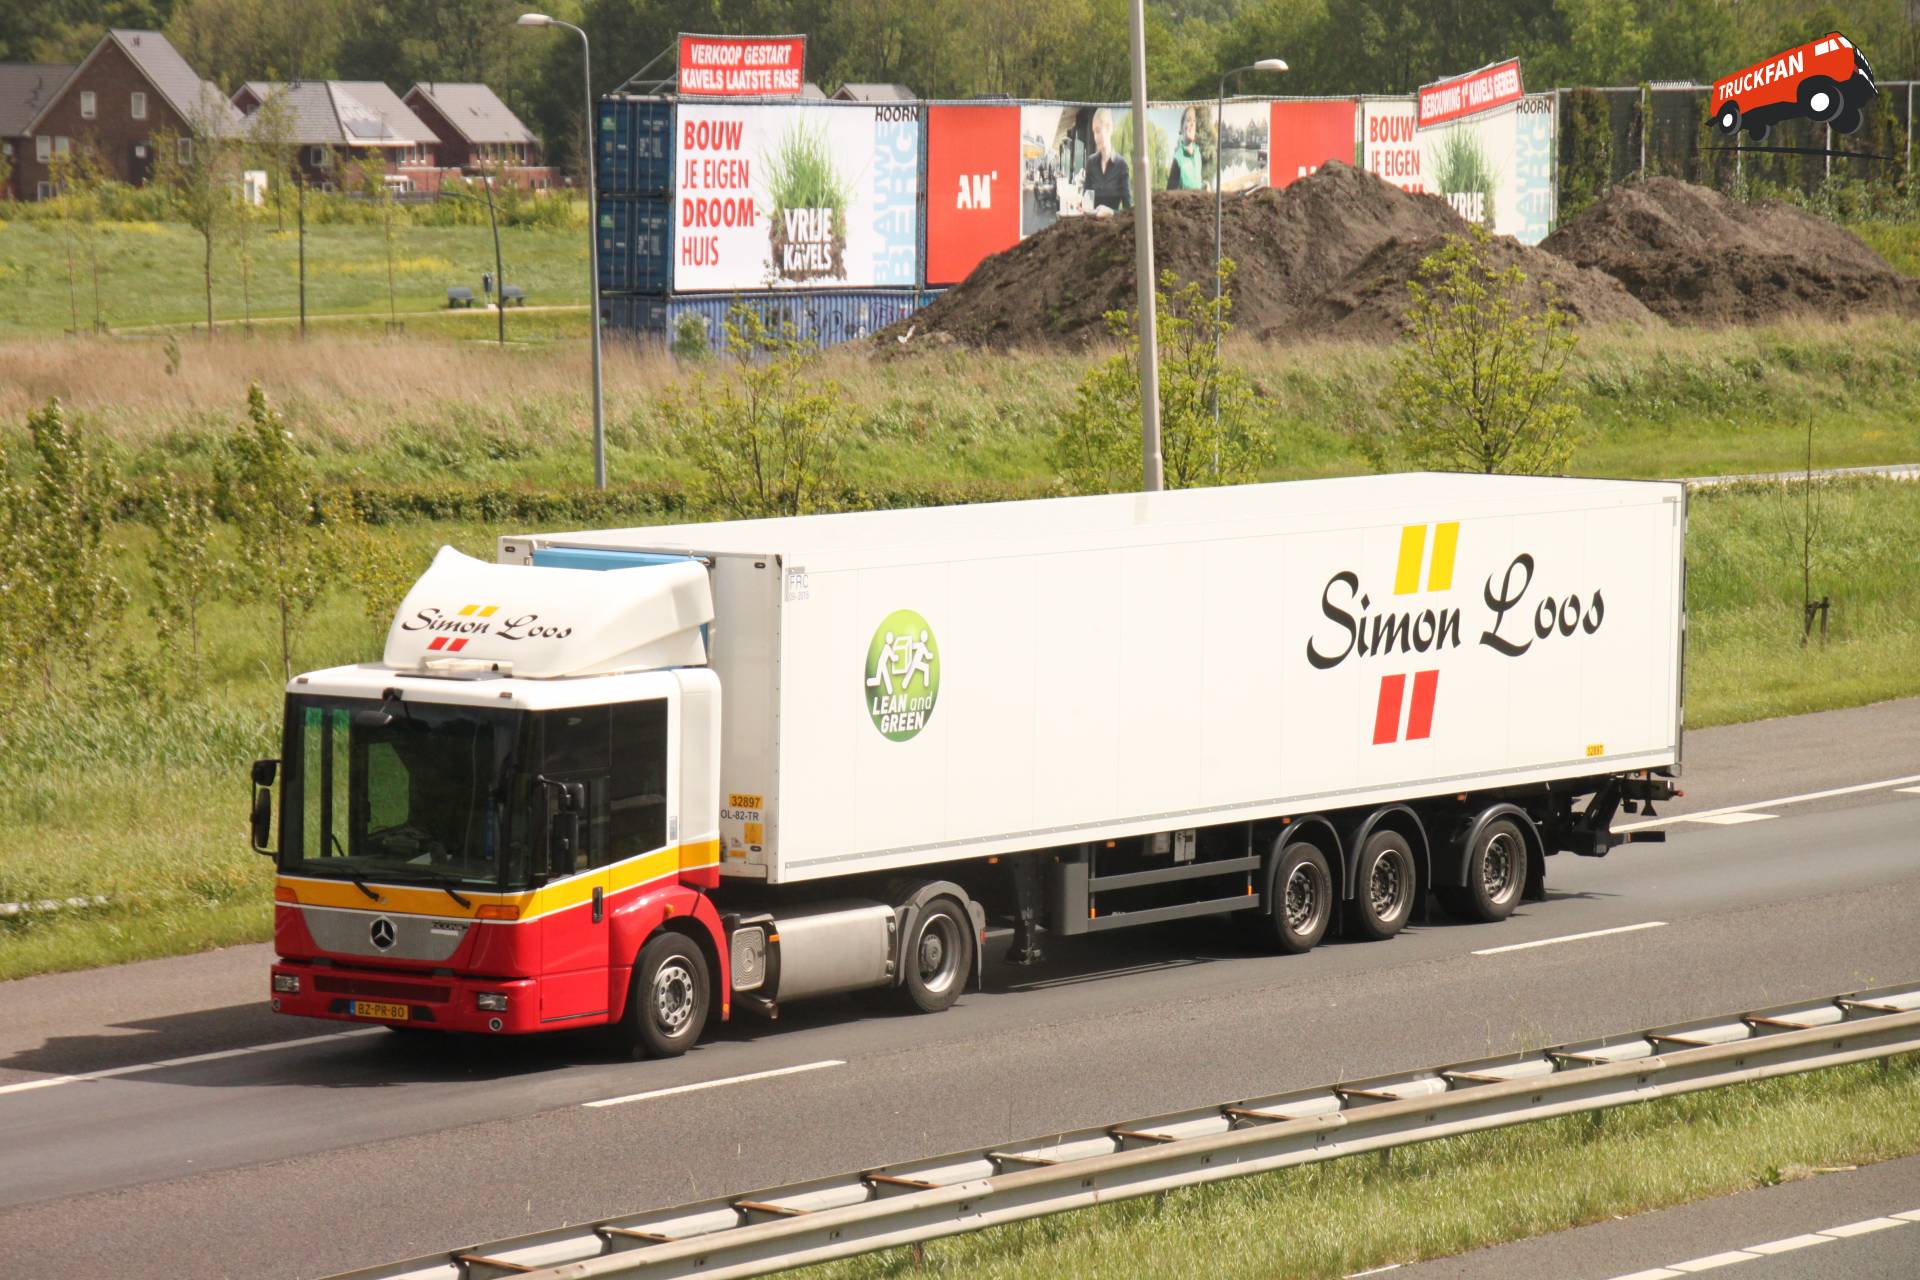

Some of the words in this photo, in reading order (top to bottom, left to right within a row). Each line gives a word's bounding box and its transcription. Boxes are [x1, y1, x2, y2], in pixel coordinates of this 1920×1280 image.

[691, 44, 742, 64] VERKOOP
[744, 45, 792, 65] GESTART
[681, 68, 723, 89] KAVELS
[726, 69, 772, 89] LAATSTE
[773, 69, 799, 88] FASE
[1469, 76, 1494, 106] KAVELS
[875, 107, 918, 122] HOORN
[1516, 100, 1551, 114] HOORN
[684, 120, 743, 150] BOUW
[1370, 116, 1415, 142] BOUW
[682, 159, 698, 189] JE
[703, 159, 749, 189] EIGEN
[1384, 150, 1420, 176] EIGEN
[889, 122, 918, 286] BERG
[957, 174, 992, 209] AM
[682, 198, 761, 227] DROOM-
[783, 208, 832, 242] VRIJE
[682, 236, 719, 266] HUIS
[783, 244, 832, 271] KAVELS
[401, 607, 490, 634] Simon
[495, 614, 572, 640] Loos
[1306, 571, 1461, 670] Simon
[1479, 553, 1605, 657] Loos
[873, 694, 908, 715] LEAN
[910, 691, 933, 711] and
[881, 711, 925, 733] GREEN
[731, 795, 761, 808] 32897
[720, 809, 759, 821] OL-82-TR
[358, 1003, 404, 1018] BZ-PR-80
